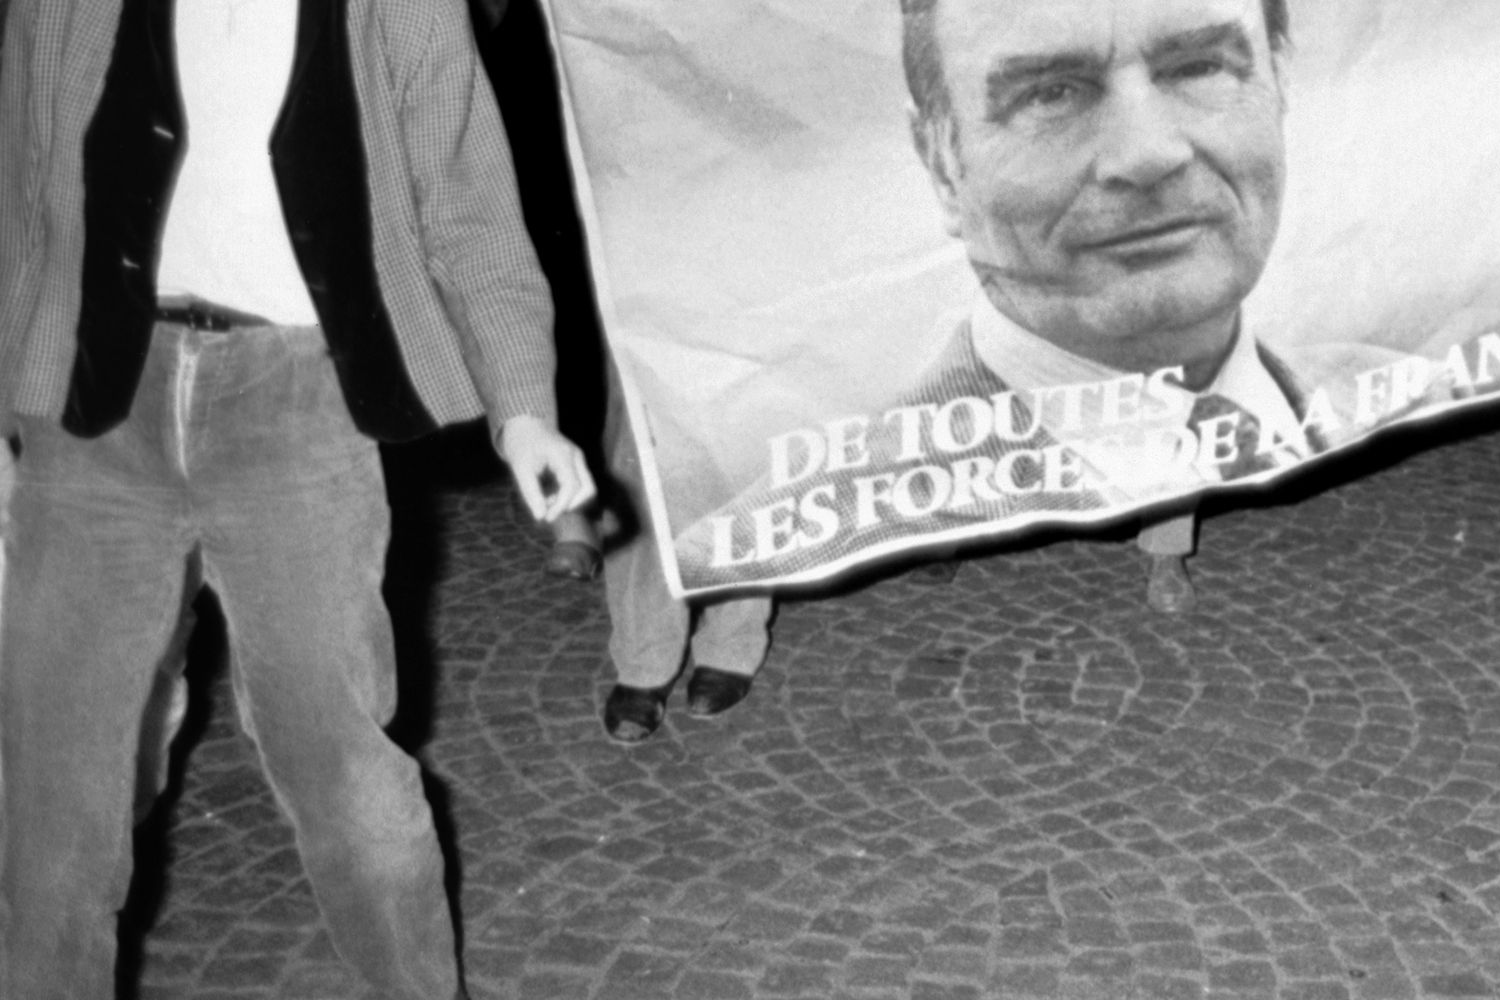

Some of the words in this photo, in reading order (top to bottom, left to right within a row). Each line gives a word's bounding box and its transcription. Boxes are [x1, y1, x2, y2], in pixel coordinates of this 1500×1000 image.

[767, 416, 871, 490] DE
[883, 365, 1186, 463] TOUTES
[708, 481, 841, 569] LES
